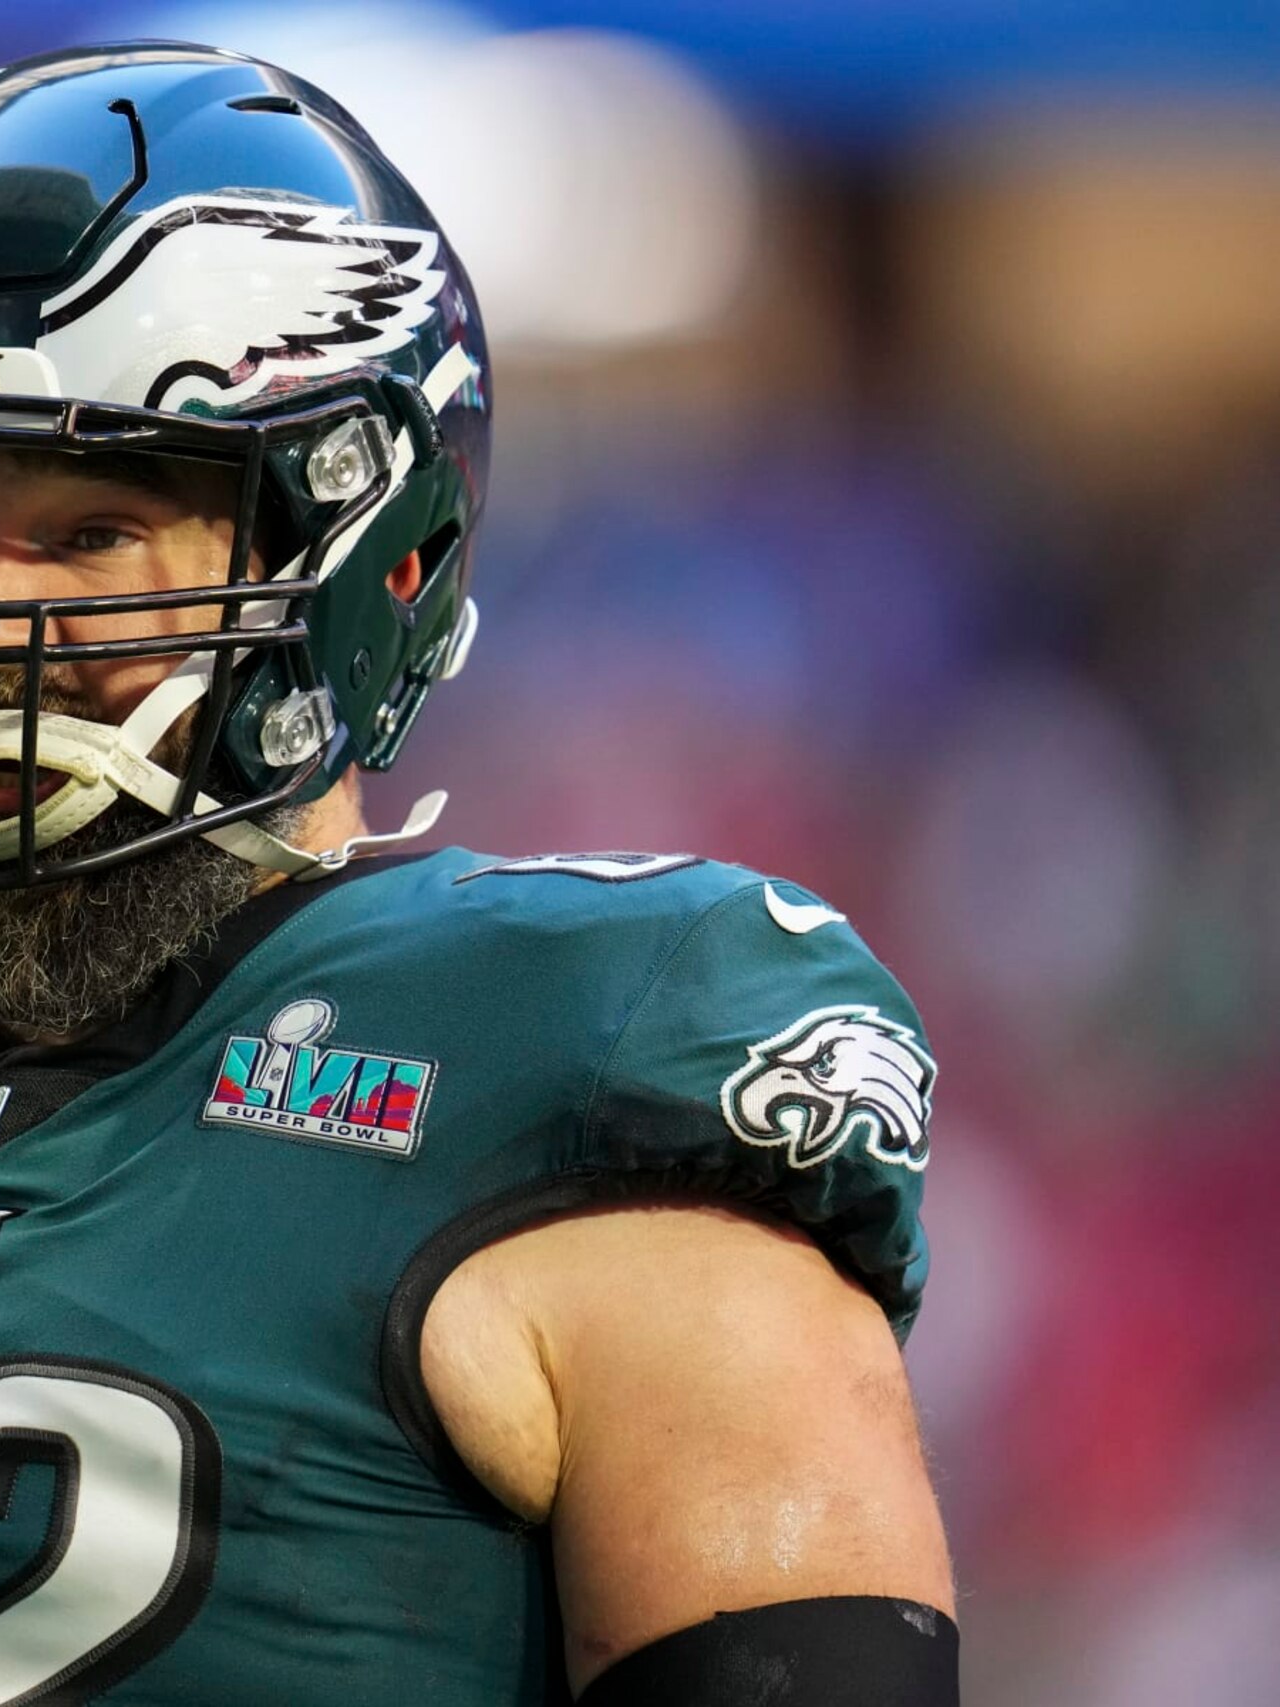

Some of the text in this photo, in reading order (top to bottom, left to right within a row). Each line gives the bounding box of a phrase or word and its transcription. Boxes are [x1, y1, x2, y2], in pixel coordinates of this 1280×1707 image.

[211, 1037, 431, 1133] LVII
[225, 1105, 389, 1143] SUPER BOWL
